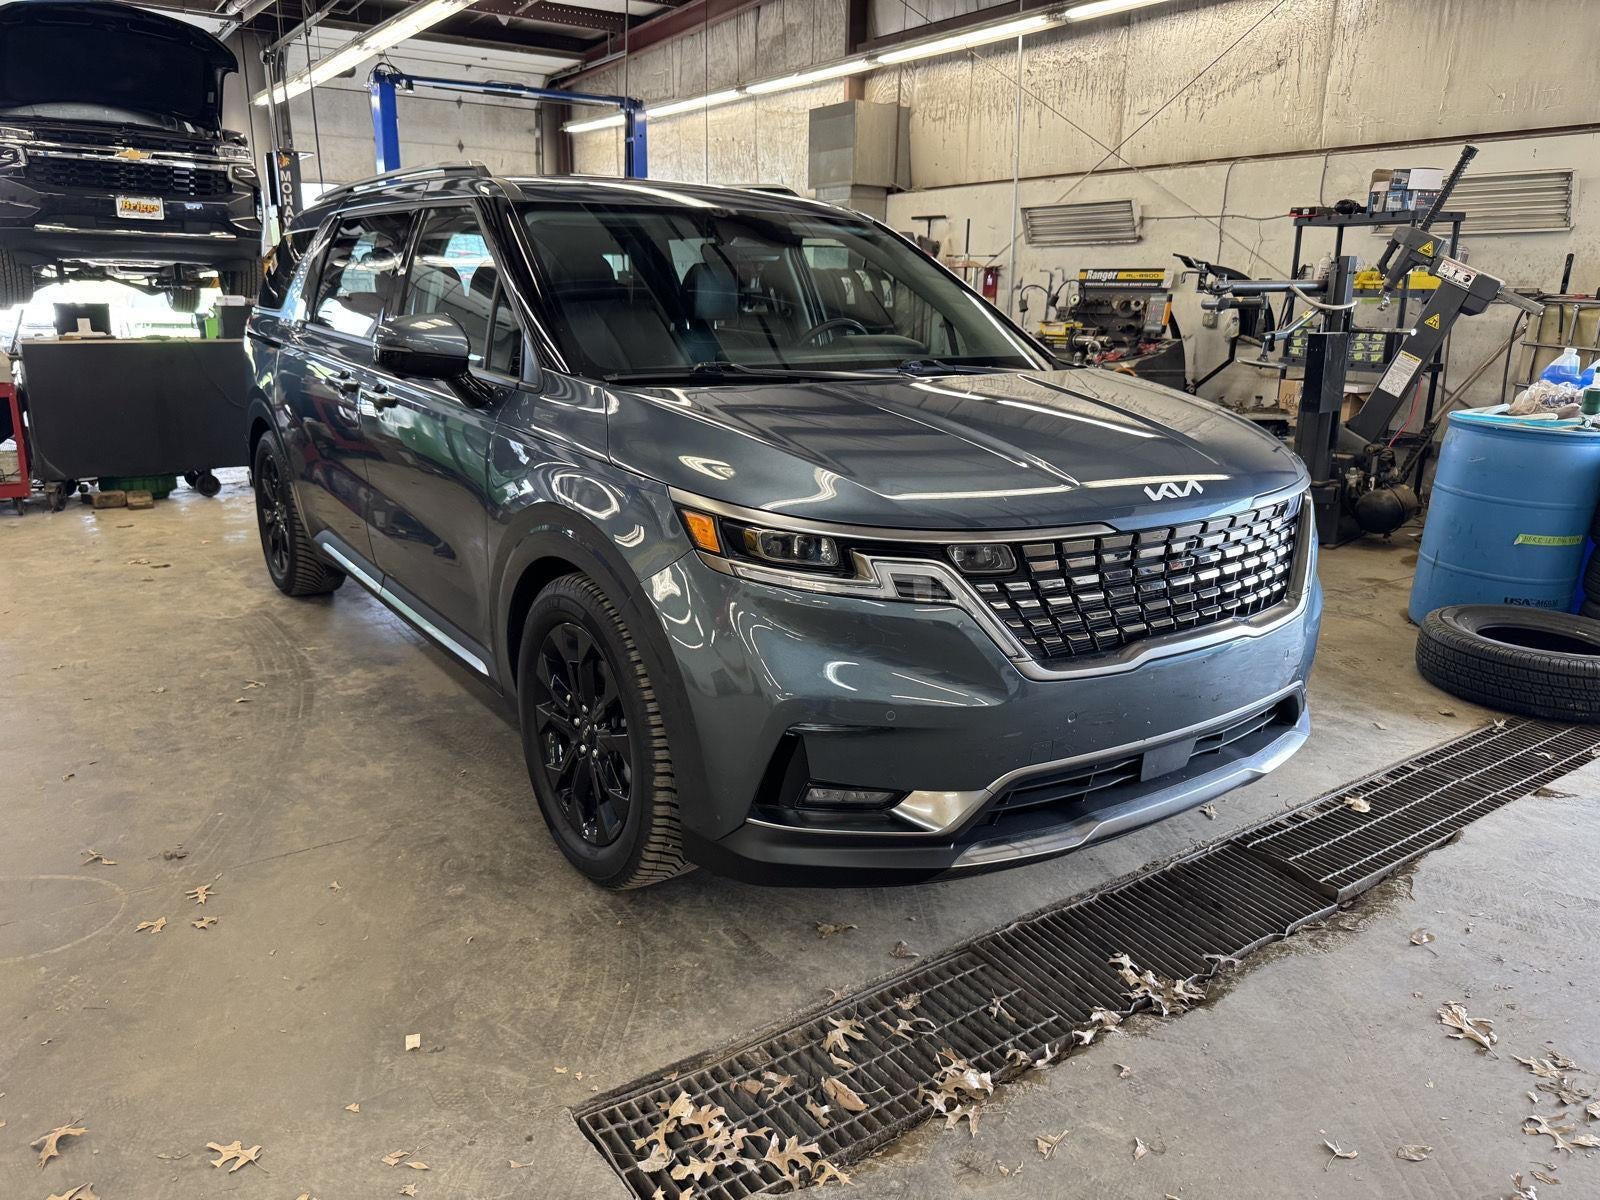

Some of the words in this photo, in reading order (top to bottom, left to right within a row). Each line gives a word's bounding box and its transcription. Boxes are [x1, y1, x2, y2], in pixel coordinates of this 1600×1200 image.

[120, 201, 160, 213] Briggs
[1086, 270, 1118, 281] Ranger
[1144, 480, 1204, 501] KIA
